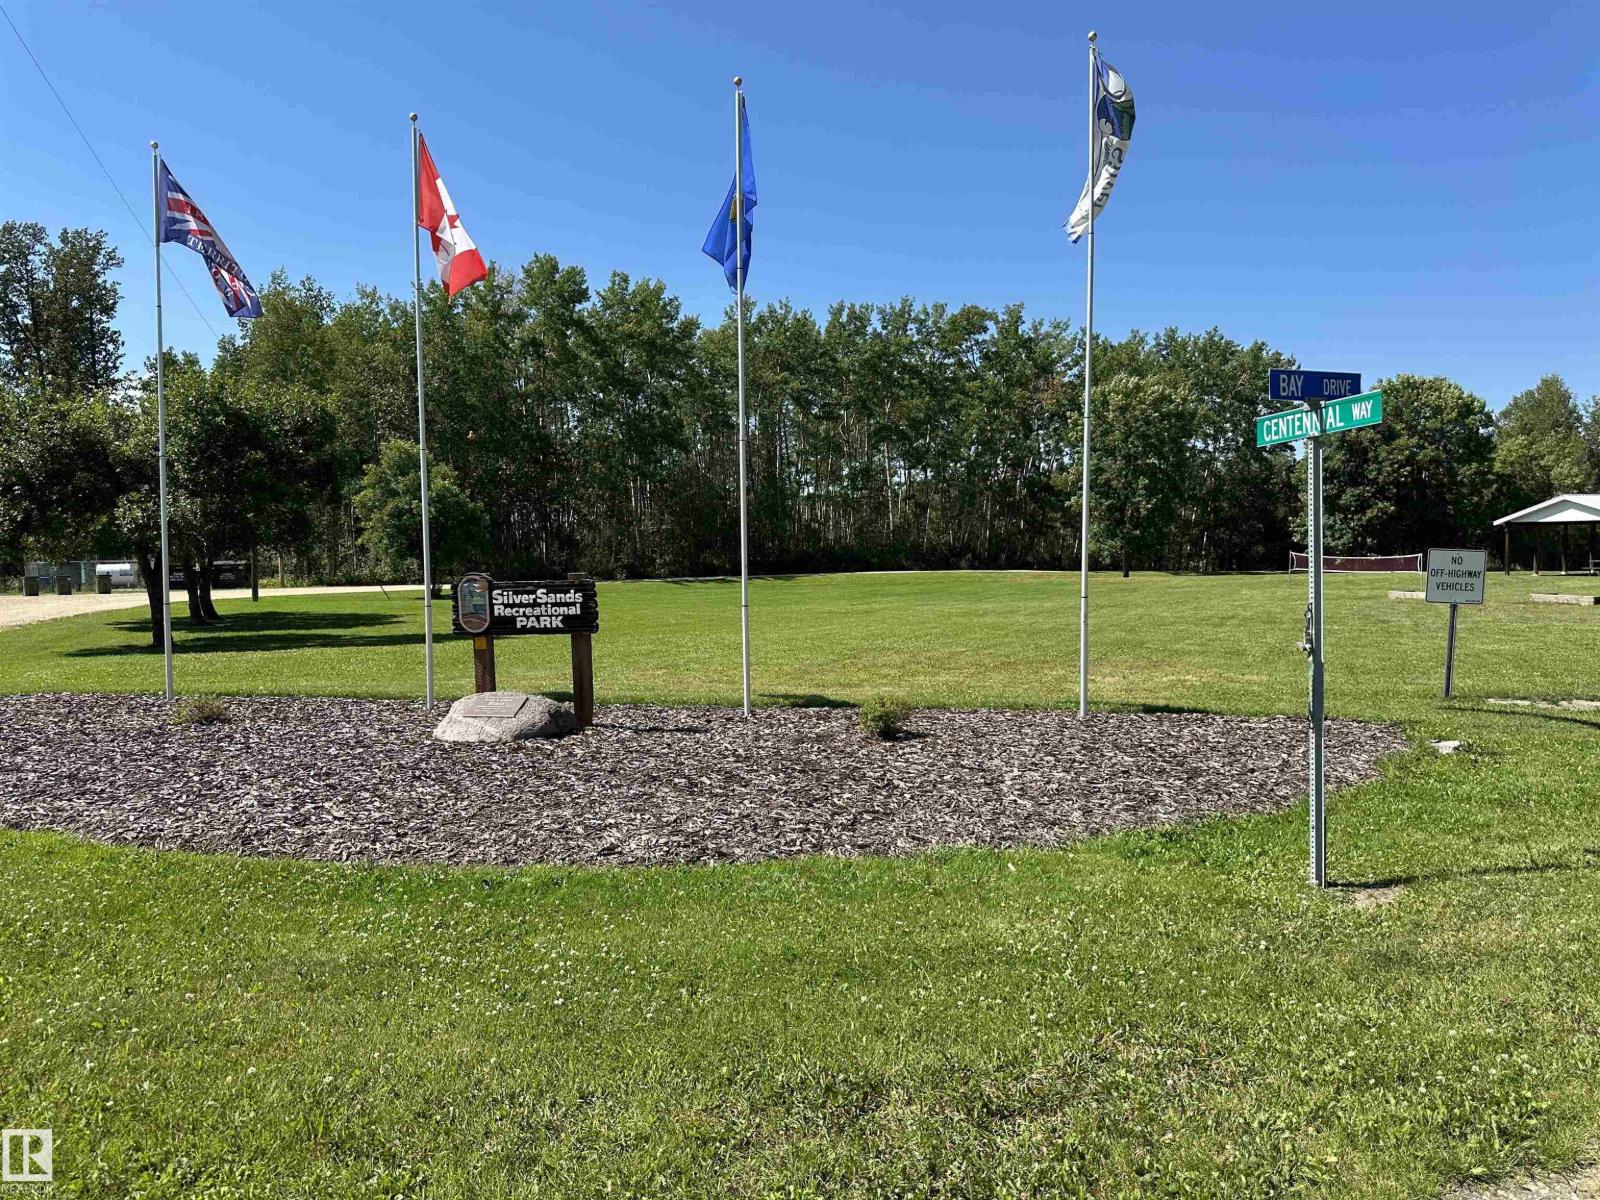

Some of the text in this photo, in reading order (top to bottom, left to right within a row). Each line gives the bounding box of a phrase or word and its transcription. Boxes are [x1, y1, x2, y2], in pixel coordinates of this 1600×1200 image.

[1279, 374, 1352, 397] BAY DRIVE
[1263, 399, 1373, 442] CENTENNIAL WAY
[1451, 556, 1463, 566] NO
[1430, 568, 1482, 579] OFF-HIGHWAY
[1435, 581, 1475, 592] VEHICLES
[493, 603, 581, 617] Recreational
[516, 615, 564, 629] PARK
